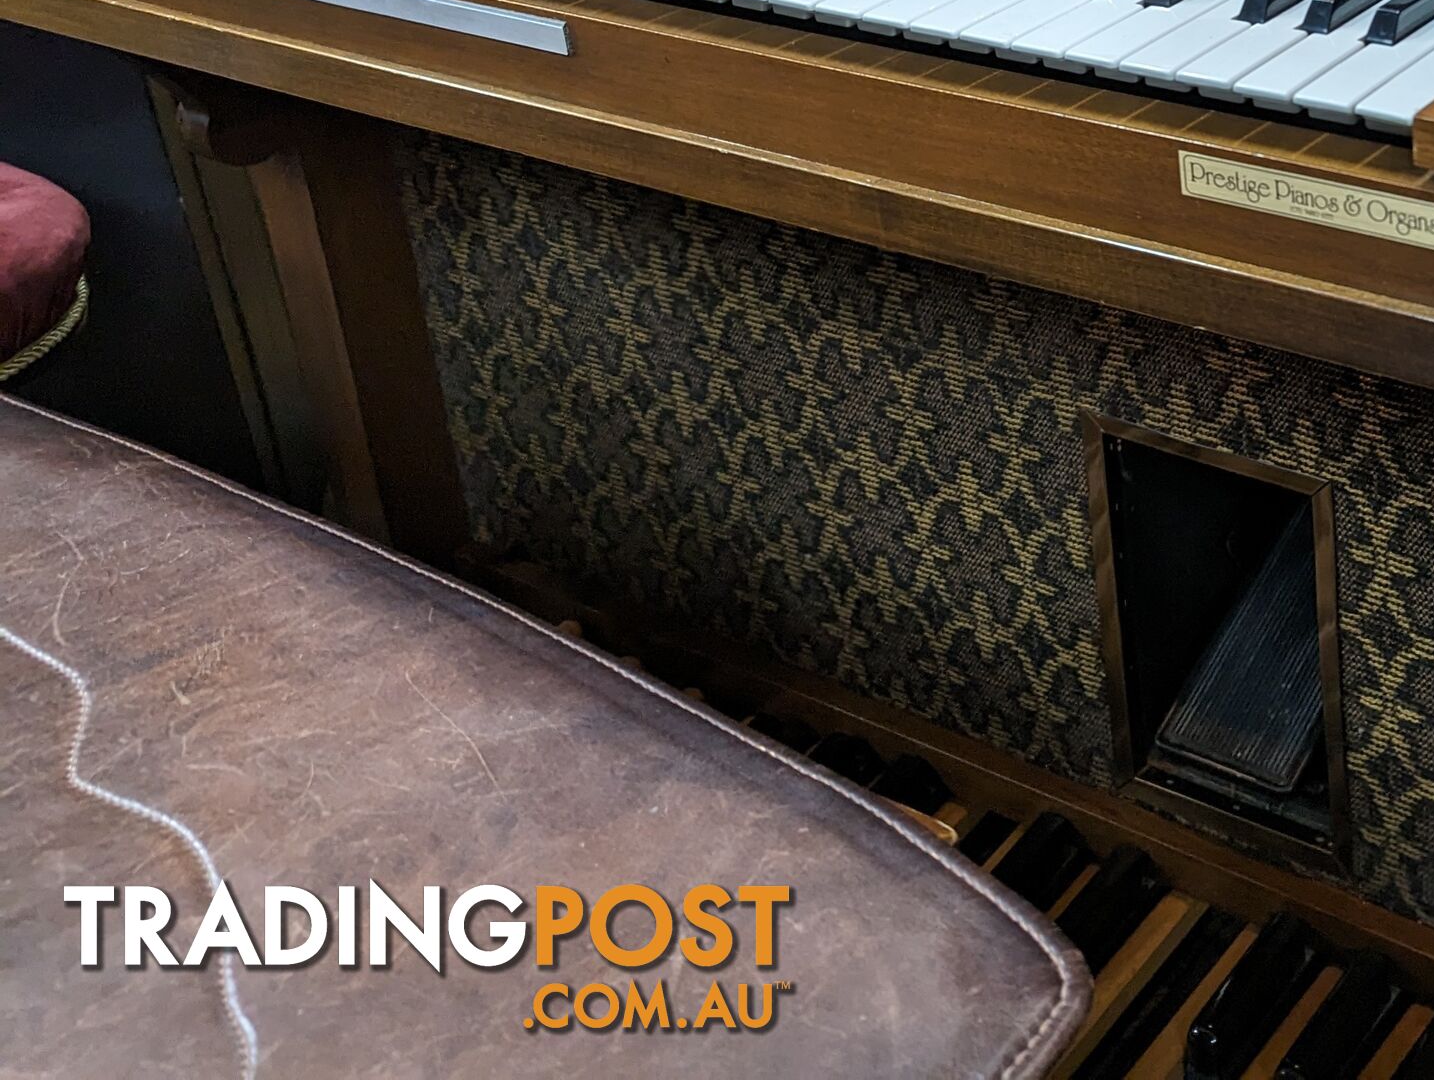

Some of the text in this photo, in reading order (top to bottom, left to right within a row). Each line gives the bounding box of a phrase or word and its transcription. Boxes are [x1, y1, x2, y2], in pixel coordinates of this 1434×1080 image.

[1189, 162, 1271, 204] Prestige
[1274, 179, 1340, 214] Pianos
[1342, 192, 1363, 216] &
